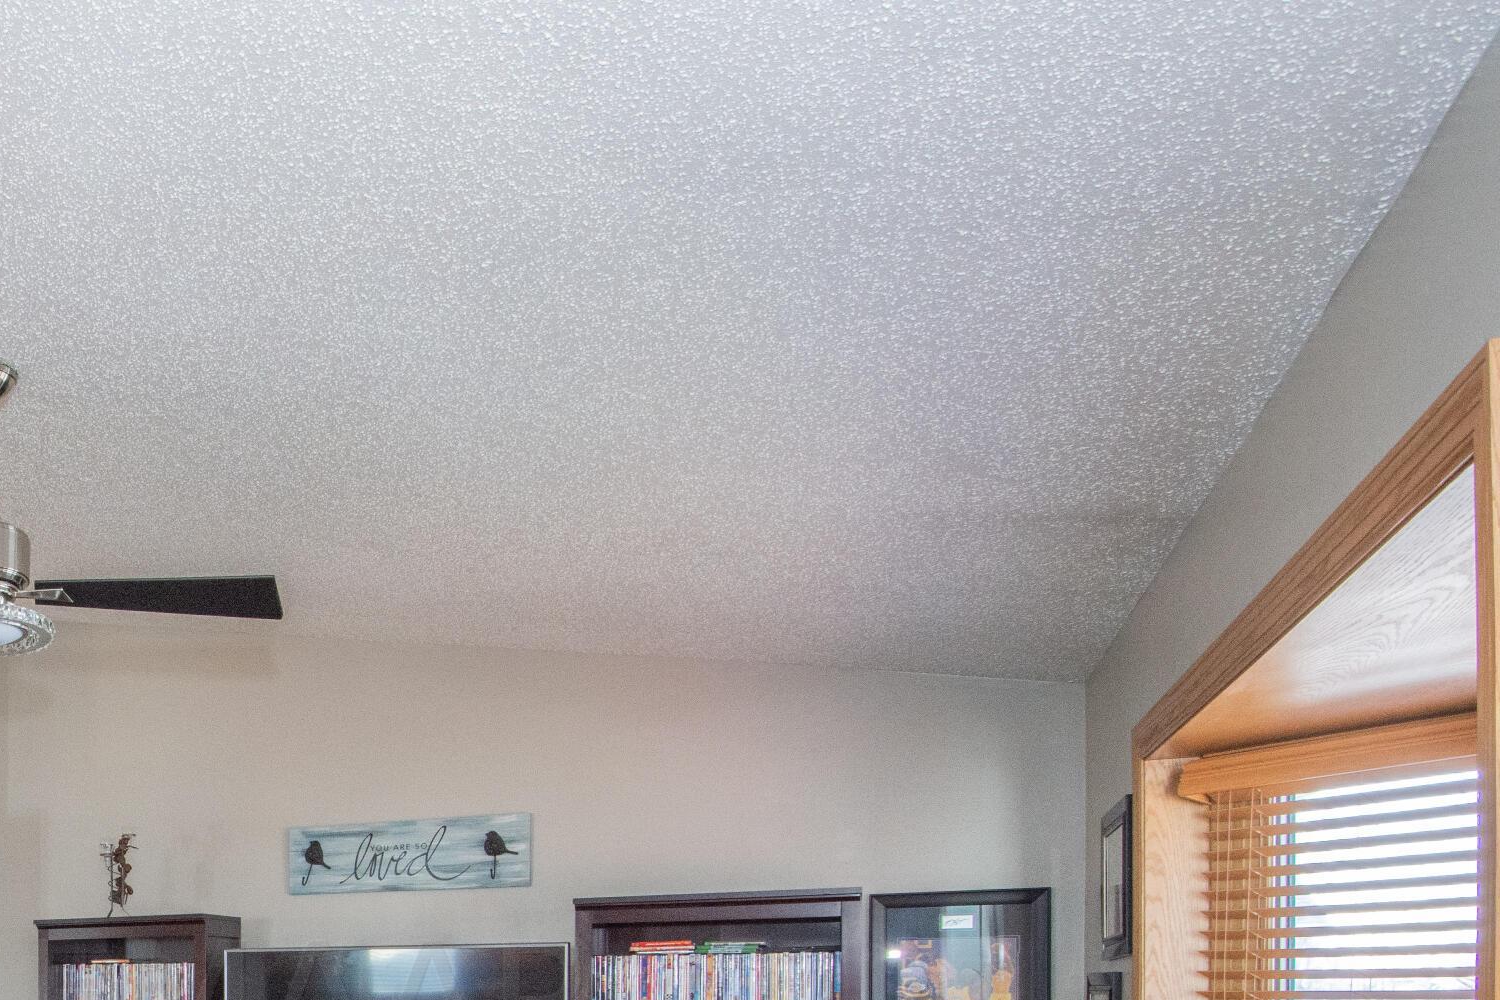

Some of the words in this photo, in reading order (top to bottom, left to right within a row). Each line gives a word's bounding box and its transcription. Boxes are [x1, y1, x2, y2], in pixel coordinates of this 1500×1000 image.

[339, 825, 471, 884] loved
[393, 843, 411, 851] ARE
[414, 842, 428, 850] SO
